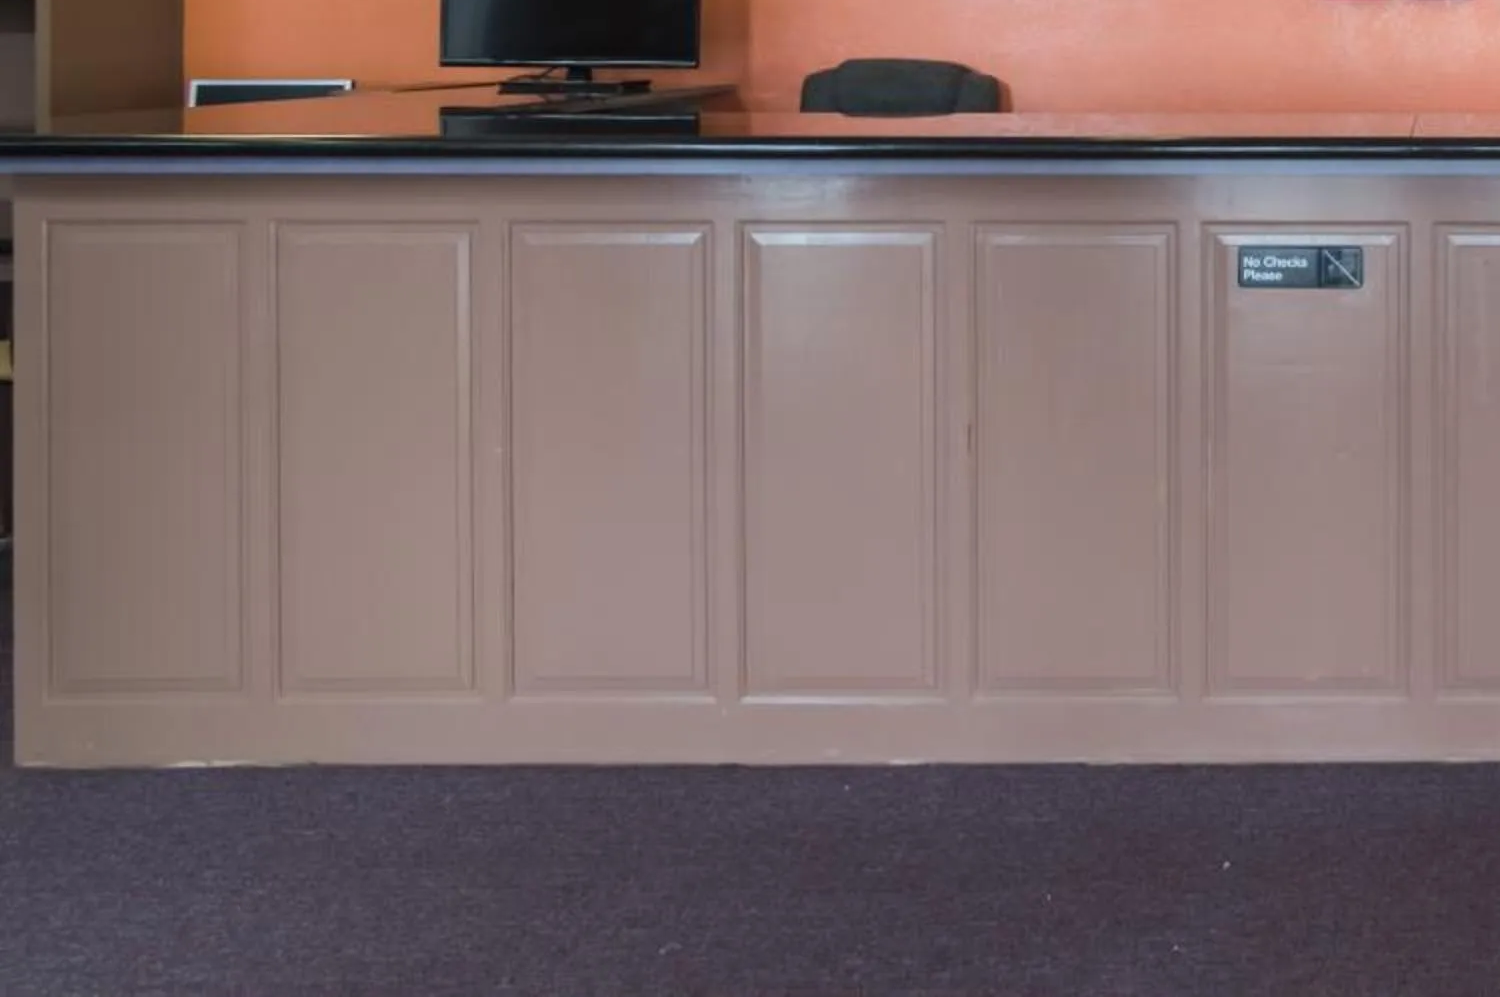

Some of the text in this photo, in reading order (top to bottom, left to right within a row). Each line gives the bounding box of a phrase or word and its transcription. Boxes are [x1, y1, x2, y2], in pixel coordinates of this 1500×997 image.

[1243, 256, 1309, 268] No Checks
[1243, 269, 1283, 282] Please
